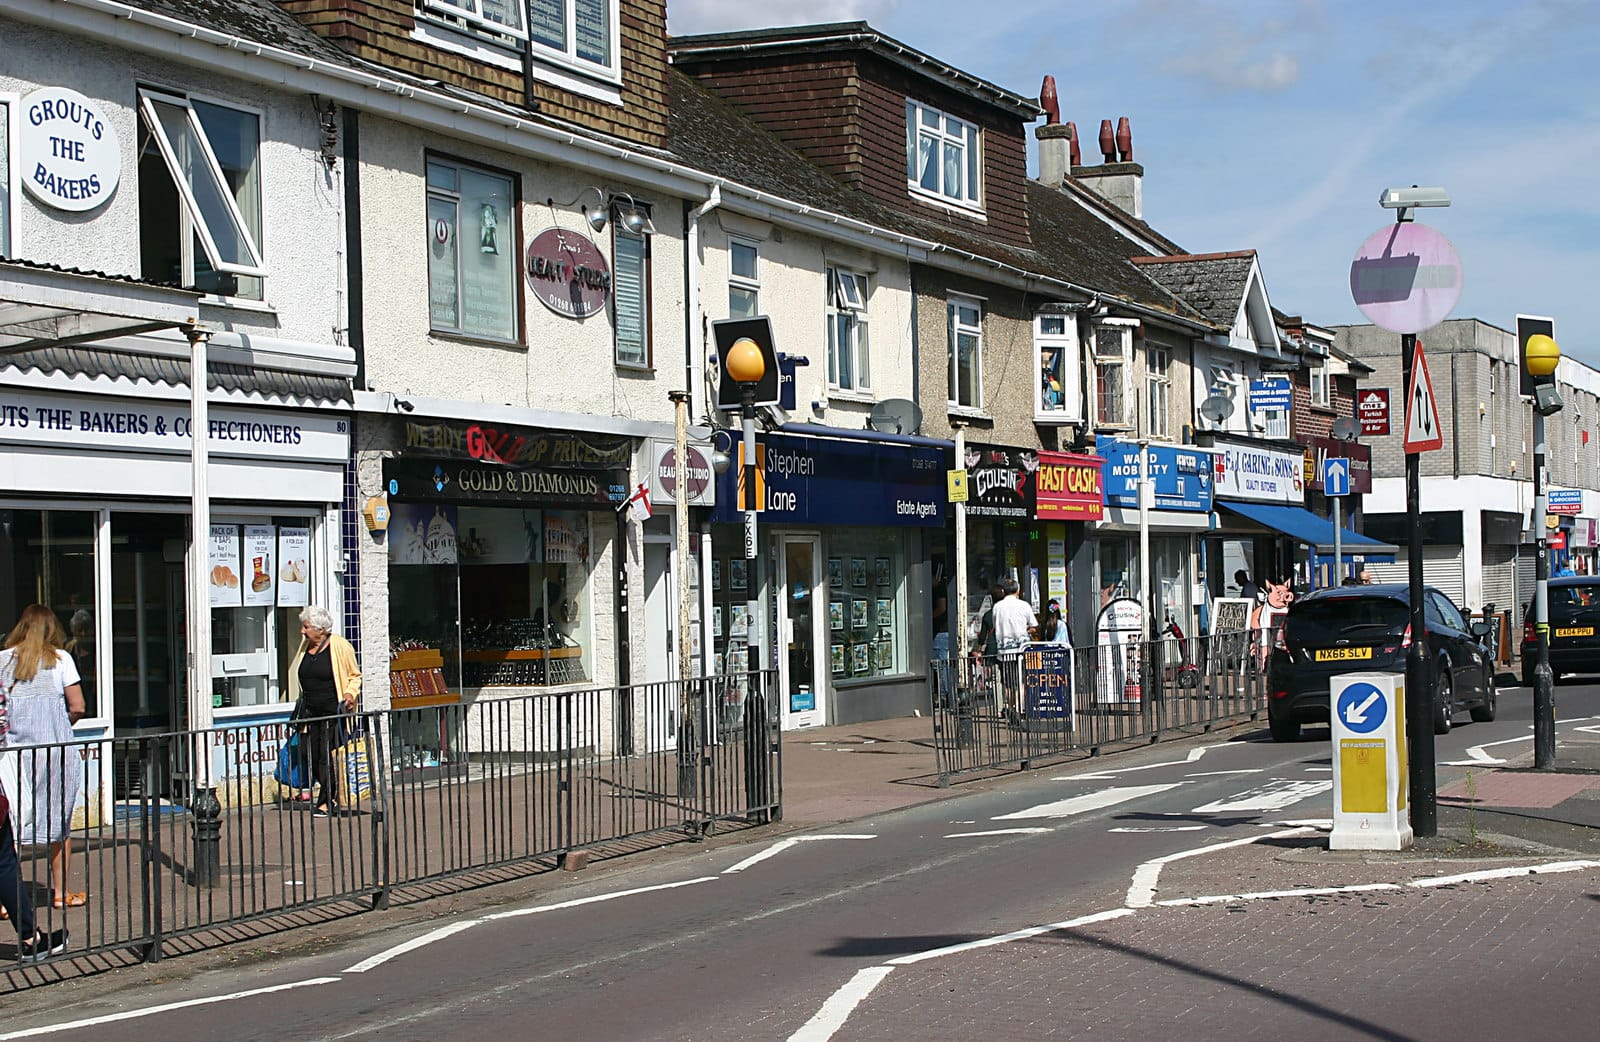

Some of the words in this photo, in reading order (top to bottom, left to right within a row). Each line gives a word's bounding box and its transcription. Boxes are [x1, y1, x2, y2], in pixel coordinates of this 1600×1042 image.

[29, 98, 104, 140] GROUTS
[50, 136, 85, 162] THE
[33, 162, 101, 200] BAKERS
[36, 408, 73, 431] THE
[80, 411, 149, 435] BAKERS
[154, 416, 168, 436] &
[174, 416, 302, 445] COFECTIONERS
[336, 421, 347, 433] 80
[767, 447, 815, 479] Stephen
[1112, 464, 1168, 476] MOBITY
[1123, 453, 1158, 465] WAD
[1241, 452, 1271, 476] GARING
[1274, 457, 1293, 479] SONS
[458, 469, 503, 491] GOLD
[506, 471, 519, 492] &
[521, 472, 598, 496] DIAMONDS
[686, 467, 709, 480] STUDIO
[1039, 464, 1067, 492] FAST
[1067, 466, 1096, 493] CASH
[767, 486, 797, 511] Lane
[896, 500, 915, 515] Estate
[916, 501, 937, 518] Agents
[211, 527, 225, 535] PACK
[225, 527, 234, 535] OF
[1319, 649, 1346, 660] NX66
[1347, 647, 1368, 659] SLV
[1026, 673, 1068, 688] OPEN
